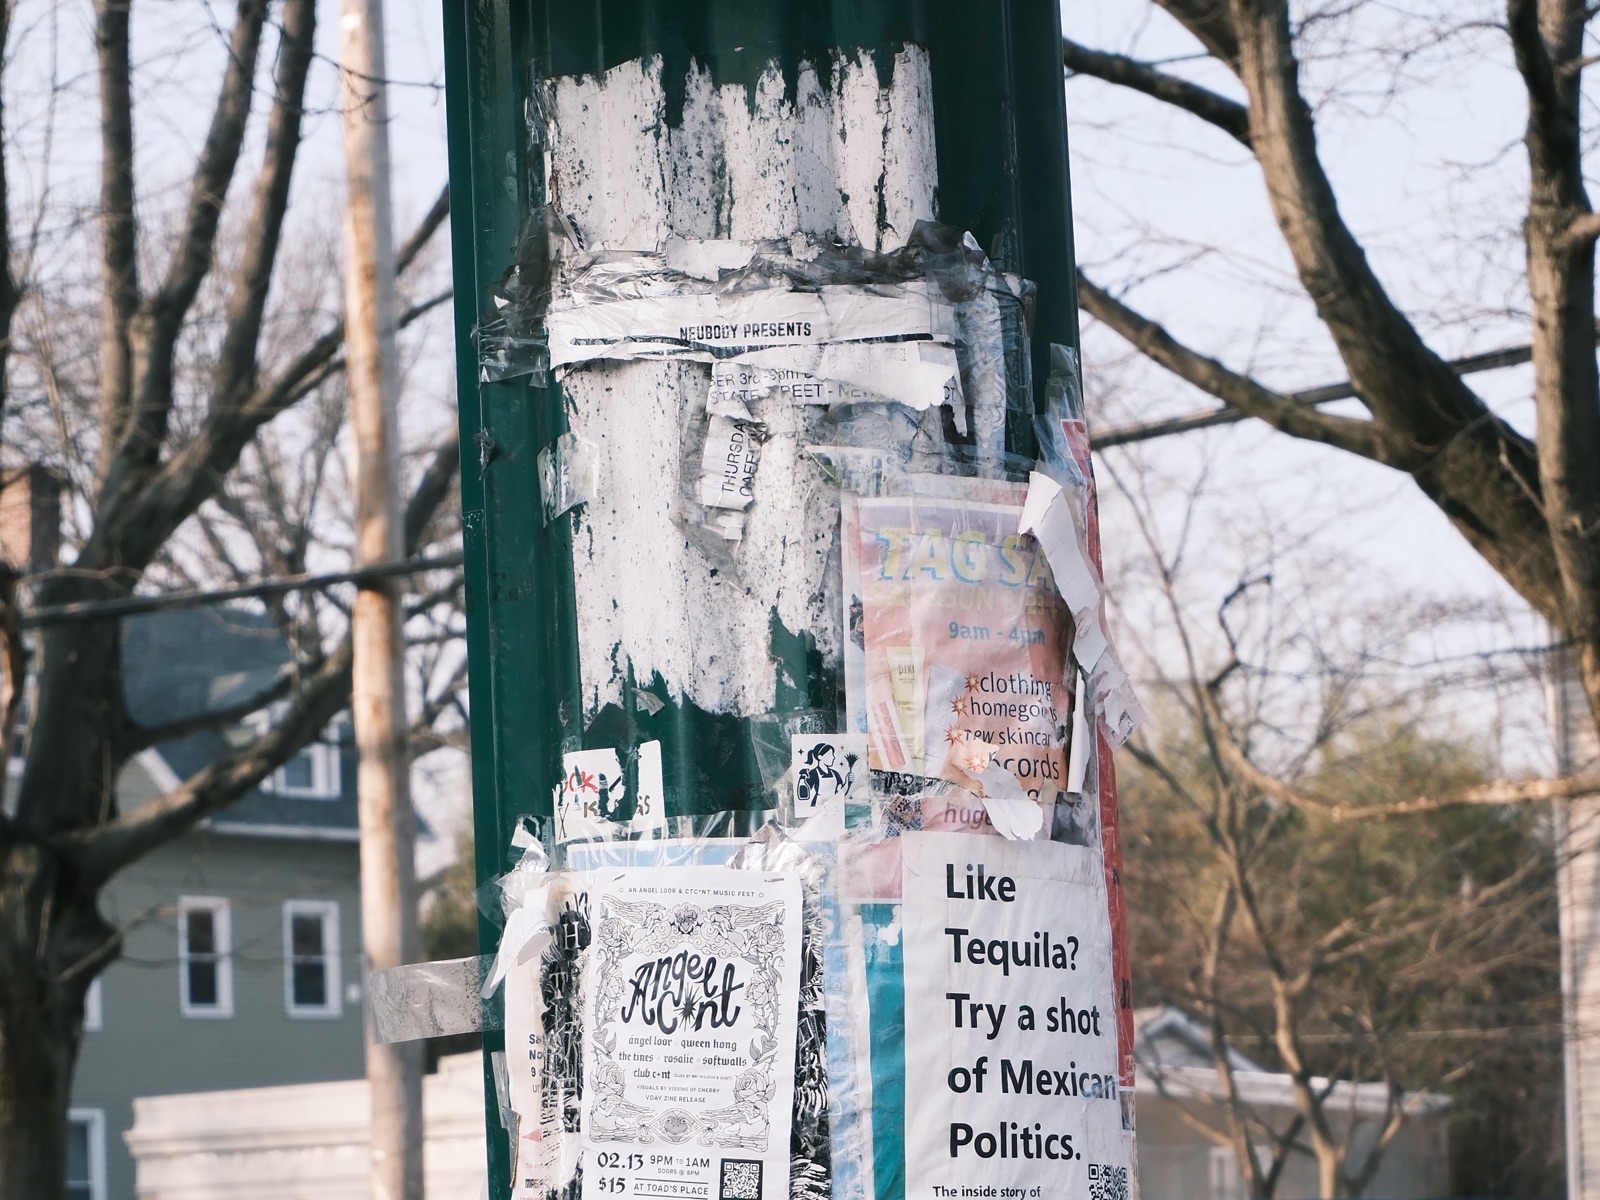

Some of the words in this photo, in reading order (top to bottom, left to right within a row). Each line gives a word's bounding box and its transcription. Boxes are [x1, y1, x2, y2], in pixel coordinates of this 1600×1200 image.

[680, 324, 737, 340] NEUBODY
[744, 322, 812, 338] PRESENTS
[876, 528, 988, 585] TAG
[949, 622, 990, 640] 9am
[1009, 626, 1045, 649] 4pm
[980, 672, 1051, 697] clothing
[946, 864, 1016, 902] Like
[945, 928, 1078, 976] Tequila?
[946, 993, 1006, 1040] Try
[1018, 1005, 1035, 1030] a
[1047, 997, 1100, 1036] shot
[629, 1035, 652, 1047] angel
[654, 1036, 672, 1046] loor
[681, 1039, 710, 1048] qween
[713, 1039, 737, 1052] hong
[619, 1052, 631, 1061] the
[664, 1054, 693, 1063] rosalie
[703, 1055, 747, 1067] softwalls
[634, 1068, 650, 1078] club
[948, 1056, 988, 1093] of
[1001, 1059, 1116, 1100] Mexican
[950, 1122, 1080, 1160] Politics.
[597, 1152, 643, 1170] 02.13
[650, 1155, 672, 1165] 9PM
[686, 1158, 710, 1168] 1AM
[599, 1175, 626, 1194] $15
[647, 1184, 677, 1193] TOAD'S
[681, 1186, 708, 1195] PLACE
[933, 1186, 957, 1197] The
[962, 1186, 996, 1197] inside
[1001, 1187, 1026, 1200] story
[1030, 1186, 1041, 1197] of
